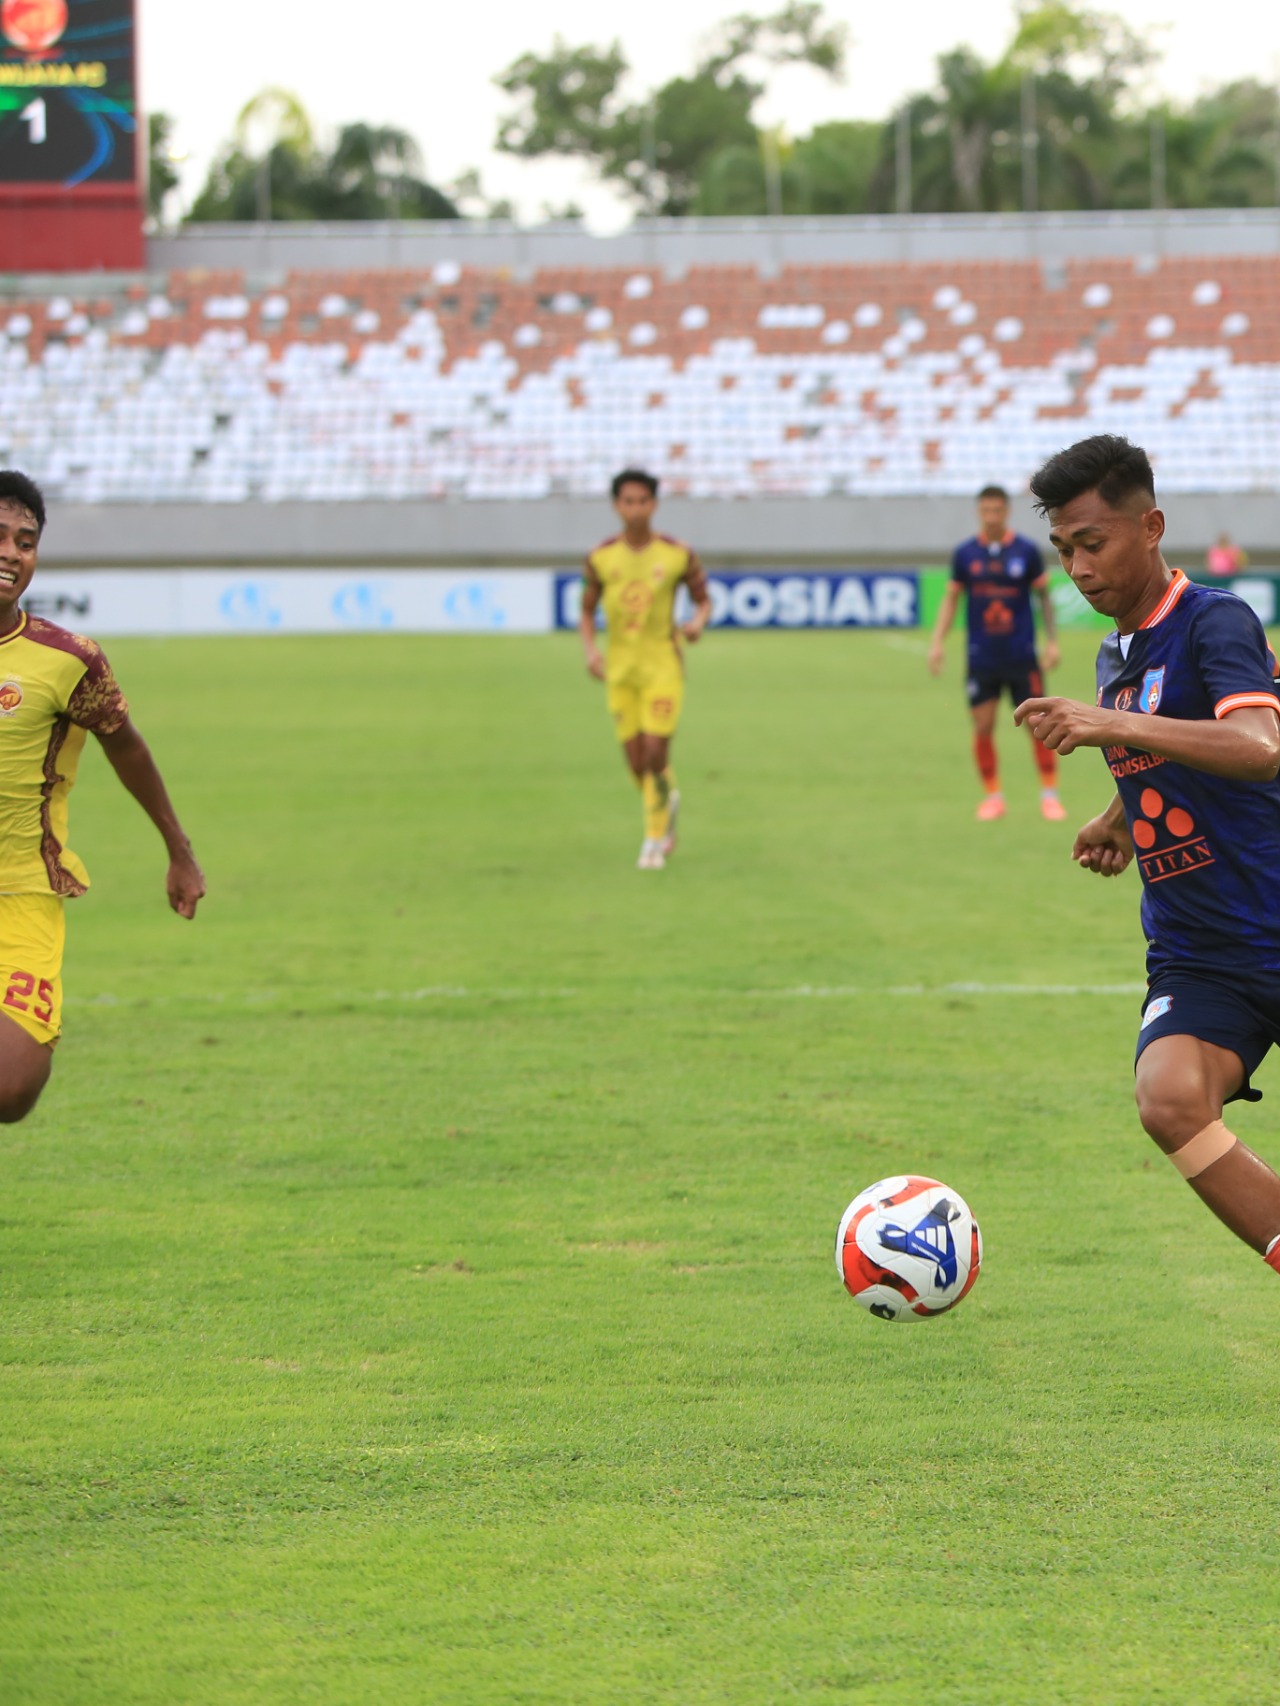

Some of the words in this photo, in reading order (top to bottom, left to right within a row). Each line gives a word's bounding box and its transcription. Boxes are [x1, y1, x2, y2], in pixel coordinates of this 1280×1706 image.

[19, 97, 46, 144] 1
[1142, 842, 1212, 877] TITAN
[3, 971, 54, 1023] 25
